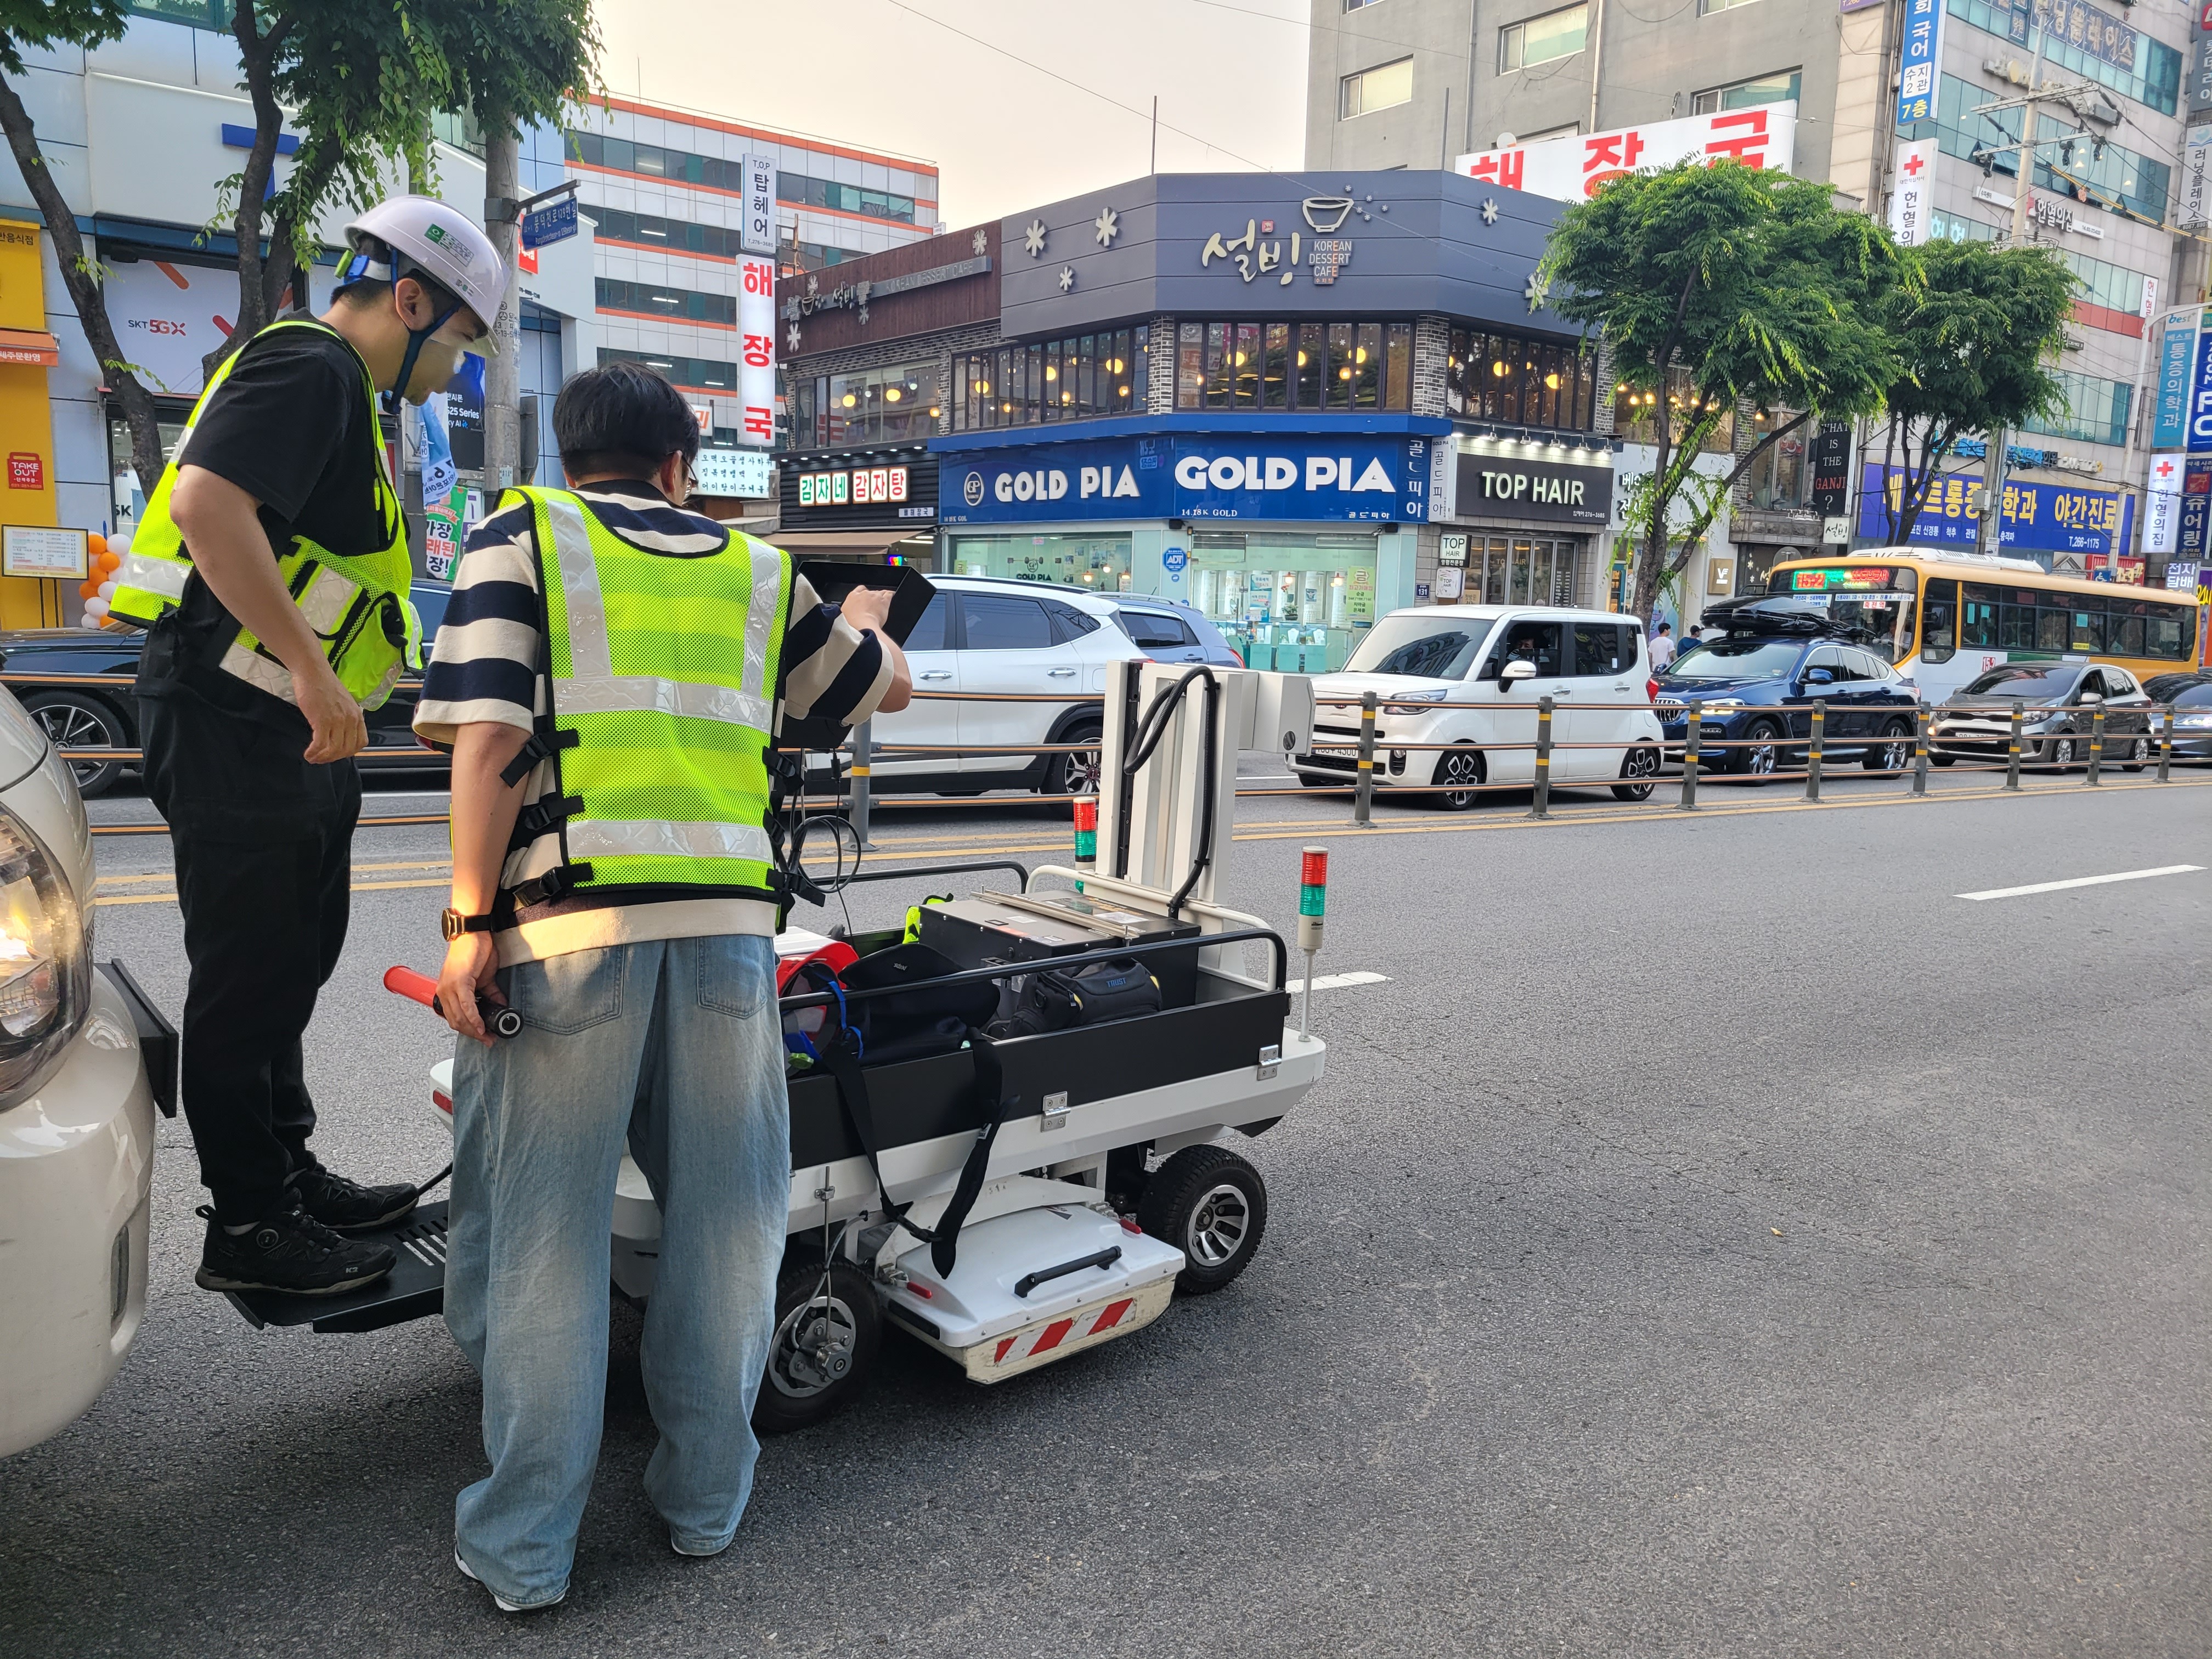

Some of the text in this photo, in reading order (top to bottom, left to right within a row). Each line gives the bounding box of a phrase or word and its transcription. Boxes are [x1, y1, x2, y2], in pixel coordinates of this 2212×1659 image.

[1911, 20, 1931, 57] 국어
[2034, 0, 2133, 66] 닝플레이스
[1906, 65, 1928, 81] 수지
[1906, 78, 1927, 94] 2관
[1902, 99, 1927, 119] 7층
[1900, 176, 1925, 184] 대한적십자사
[2187, 149, 2206, 223] 러닝플레이스
[754, 173, 769, 237] 탑헤어
[2038, 197, 2074, 233] 헌혈의집
[1202, 219, 1300, 285] 설빙
[1314, 240, 1352, 251] KOREAN
[1309, 253, 1350, 263] DESSERT
[953, 261, 973, 276] CAFE
[1314, 266, 1338, 276] CAFE
[2168, 313, 2192, 324] best
[128, 319, 186, 336] SKT 5GX
[2166, 332, 2192, 341] 베스트
[743, 262, 772, 439] 해장국
[2162, 343, 2186, 428] 통증의학과
[459, 409, 479, 419] Series
[1829, 439, 1838, 449] IS
[1822, 456, 1842, 466] THE
[1175, 456, 1396, 493] GOLD PIA
[802, 472, 904, 501] 감자네 감자탕
[995, 464, 1140, 502] GOLD PIA
[1433, 451, 1444, 515] 골드피아
[1482, 471, 1584, 505] TOP HAIR
[1815, 477, 1846, 490] GANJI
[1825, 495, 1833, 510] ?
[1348, 511, 1390, 519] 골드피아
[2055, 493, 2117, 531] 야간진료
[2152, 488, 2168, 545] 헌혈의집
[1825, 523, 1847, 538] 설빙
[1923, 525, 1939, 537] 신경통
[1946, 527, 1956, 538] 척추
[1965, 528, 1976, 539] 관절
[2000, 531, 2015, 542] 충격파
[1443, 538, 1465, 549] TOP
[2069, 536, 2100, 549] T.266-1175
[1167, 555, 1183, 564] ADT
[1356, 571, 1367, 582] 금
[2168, 563, 2196, 575] 전자
[1797, 573, 1824, 588] 15-2
[2167, 576, 2193, 588] 담배
[1106, 977, 1126, 988] TRUST
